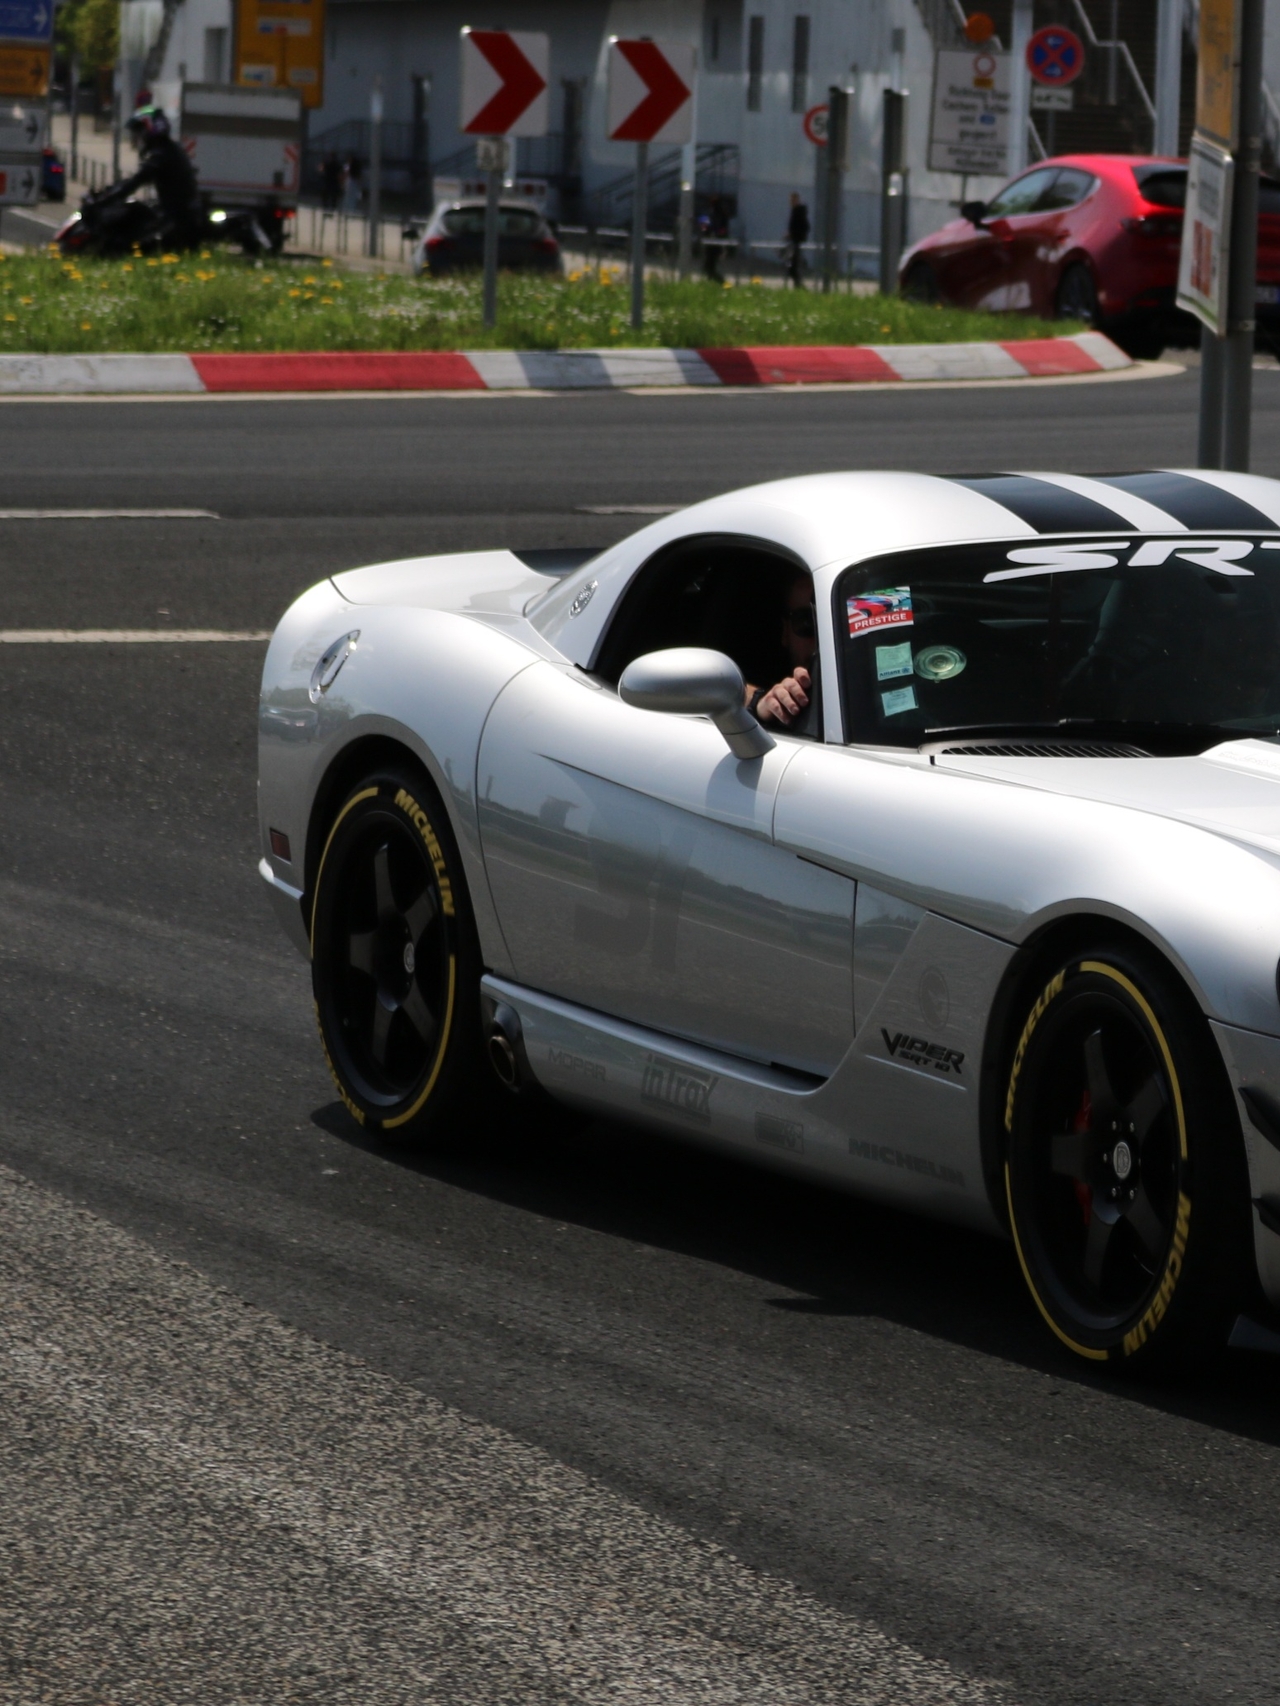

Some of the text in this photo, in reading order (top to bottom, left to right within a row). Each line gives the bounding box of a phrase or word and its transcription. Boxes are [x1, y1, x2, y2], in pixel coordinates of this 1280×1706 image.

[854, 612, 907, 630] PRESTIGE
[395, 788, 455, 917] MICHELIN
[548, 1047, 606, 1082] MOPAR
[881, 1028, 965, 1074] VIPER
[1004, 967, 1066, 1133] MICHELIN
[848, 1138, 966, 1188] MICHELIN
[1122, 1190, 1192, 1359] MICHELIN
